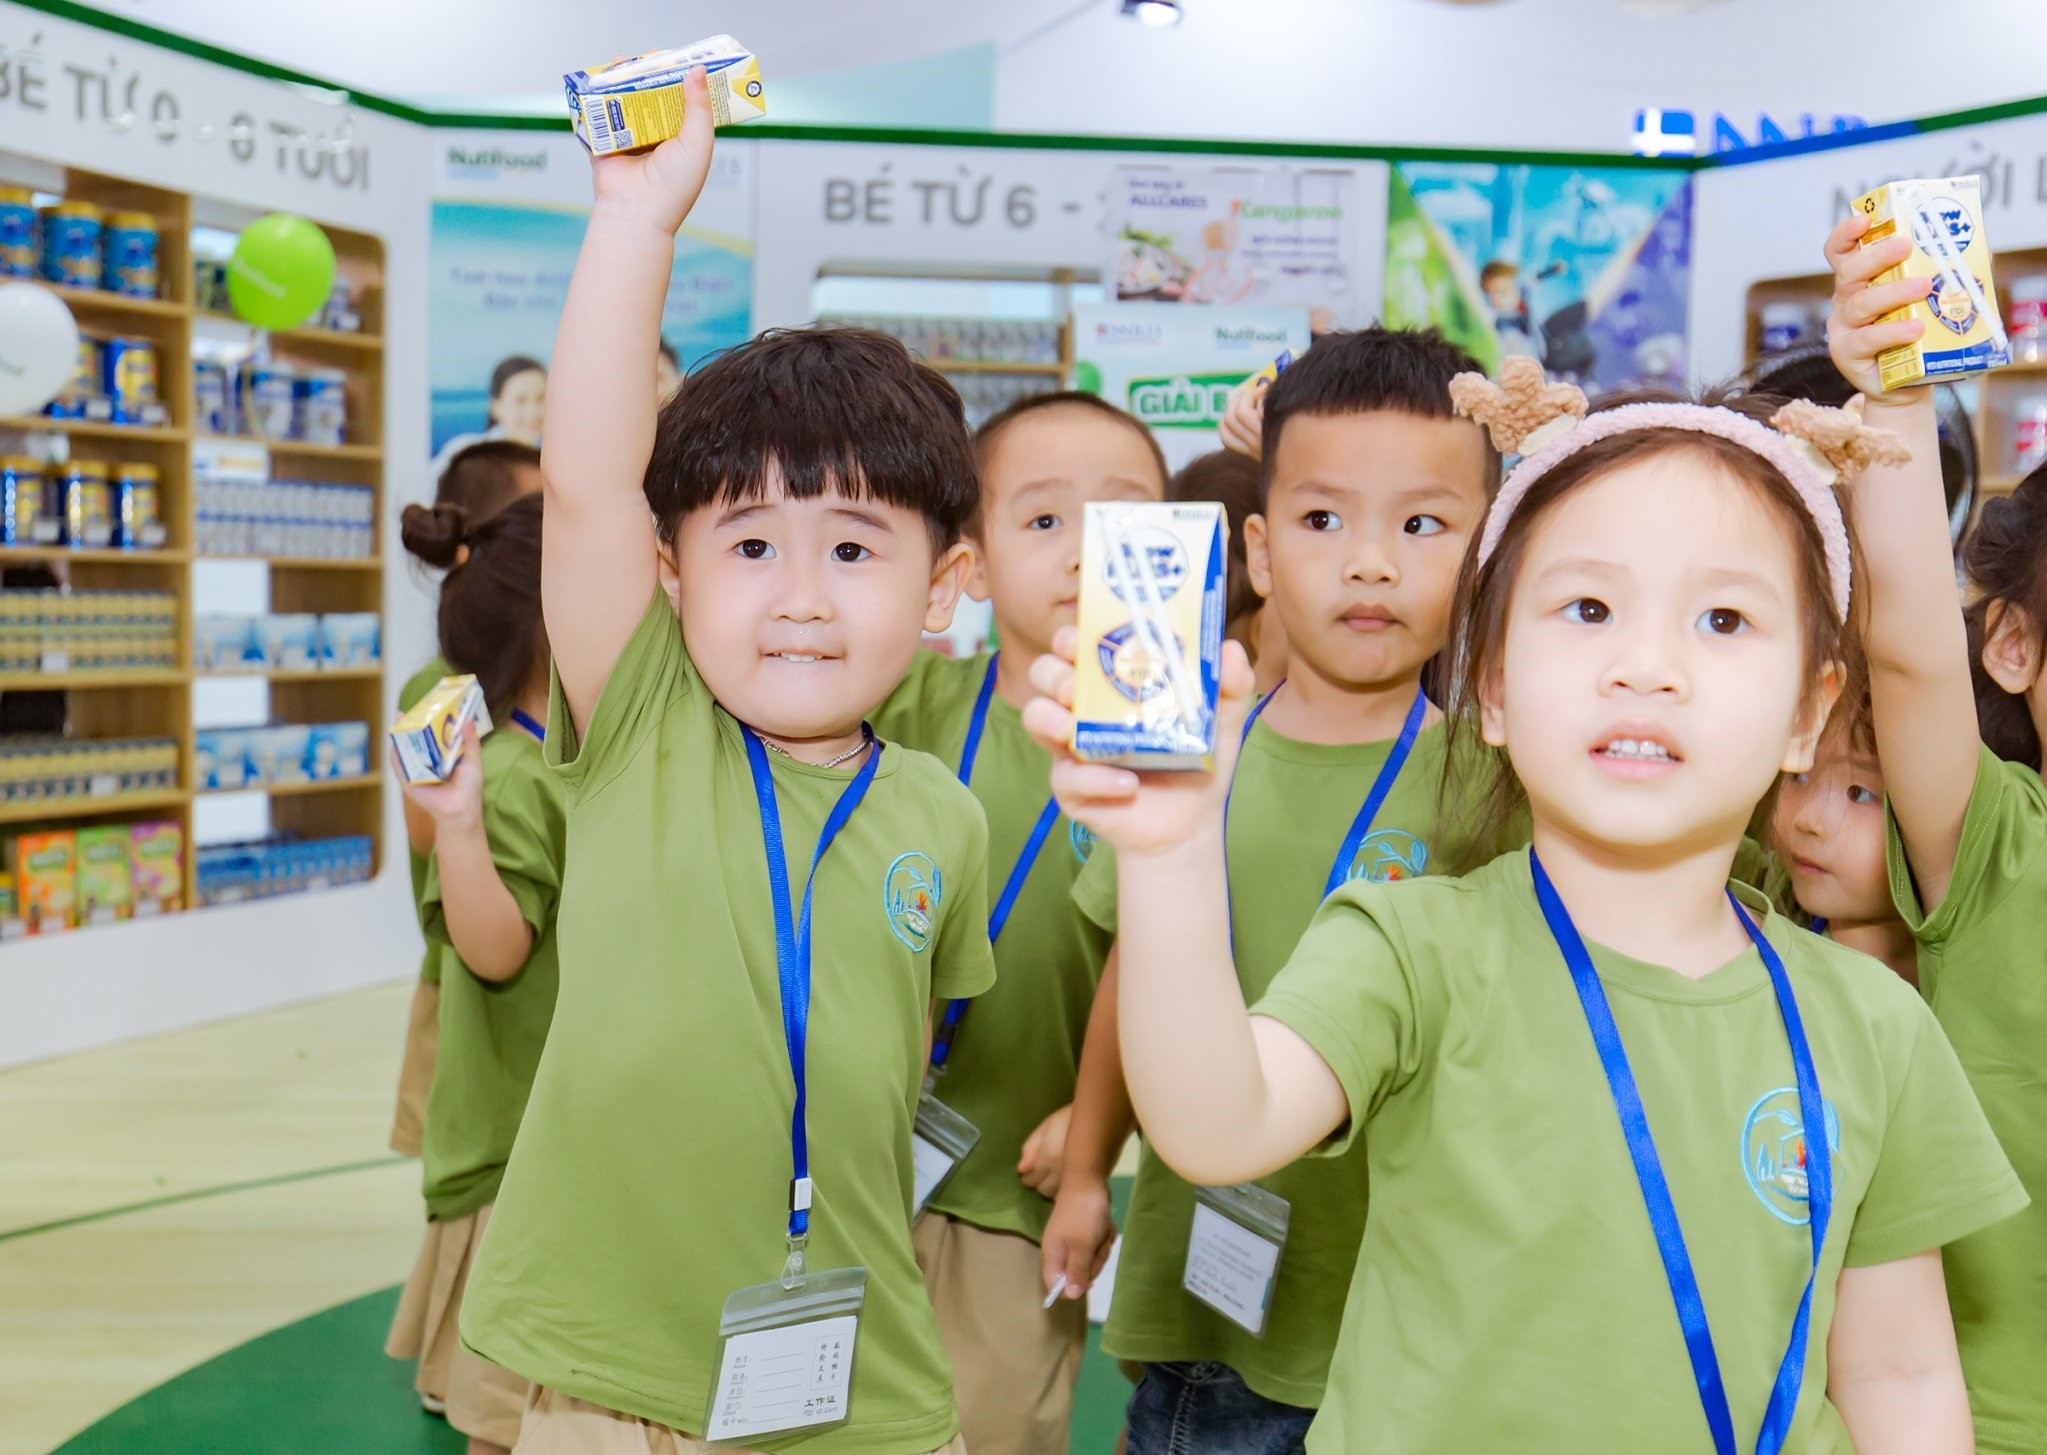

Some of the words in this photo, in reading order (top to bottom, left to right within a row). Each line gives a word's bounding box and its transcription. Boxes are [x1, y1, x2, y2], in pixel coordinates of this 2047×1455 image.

[825, 162, 894, 224] BÉ
[910, 164, 993, 226] TỪ
[1005, 184, 1038, 230] 6
